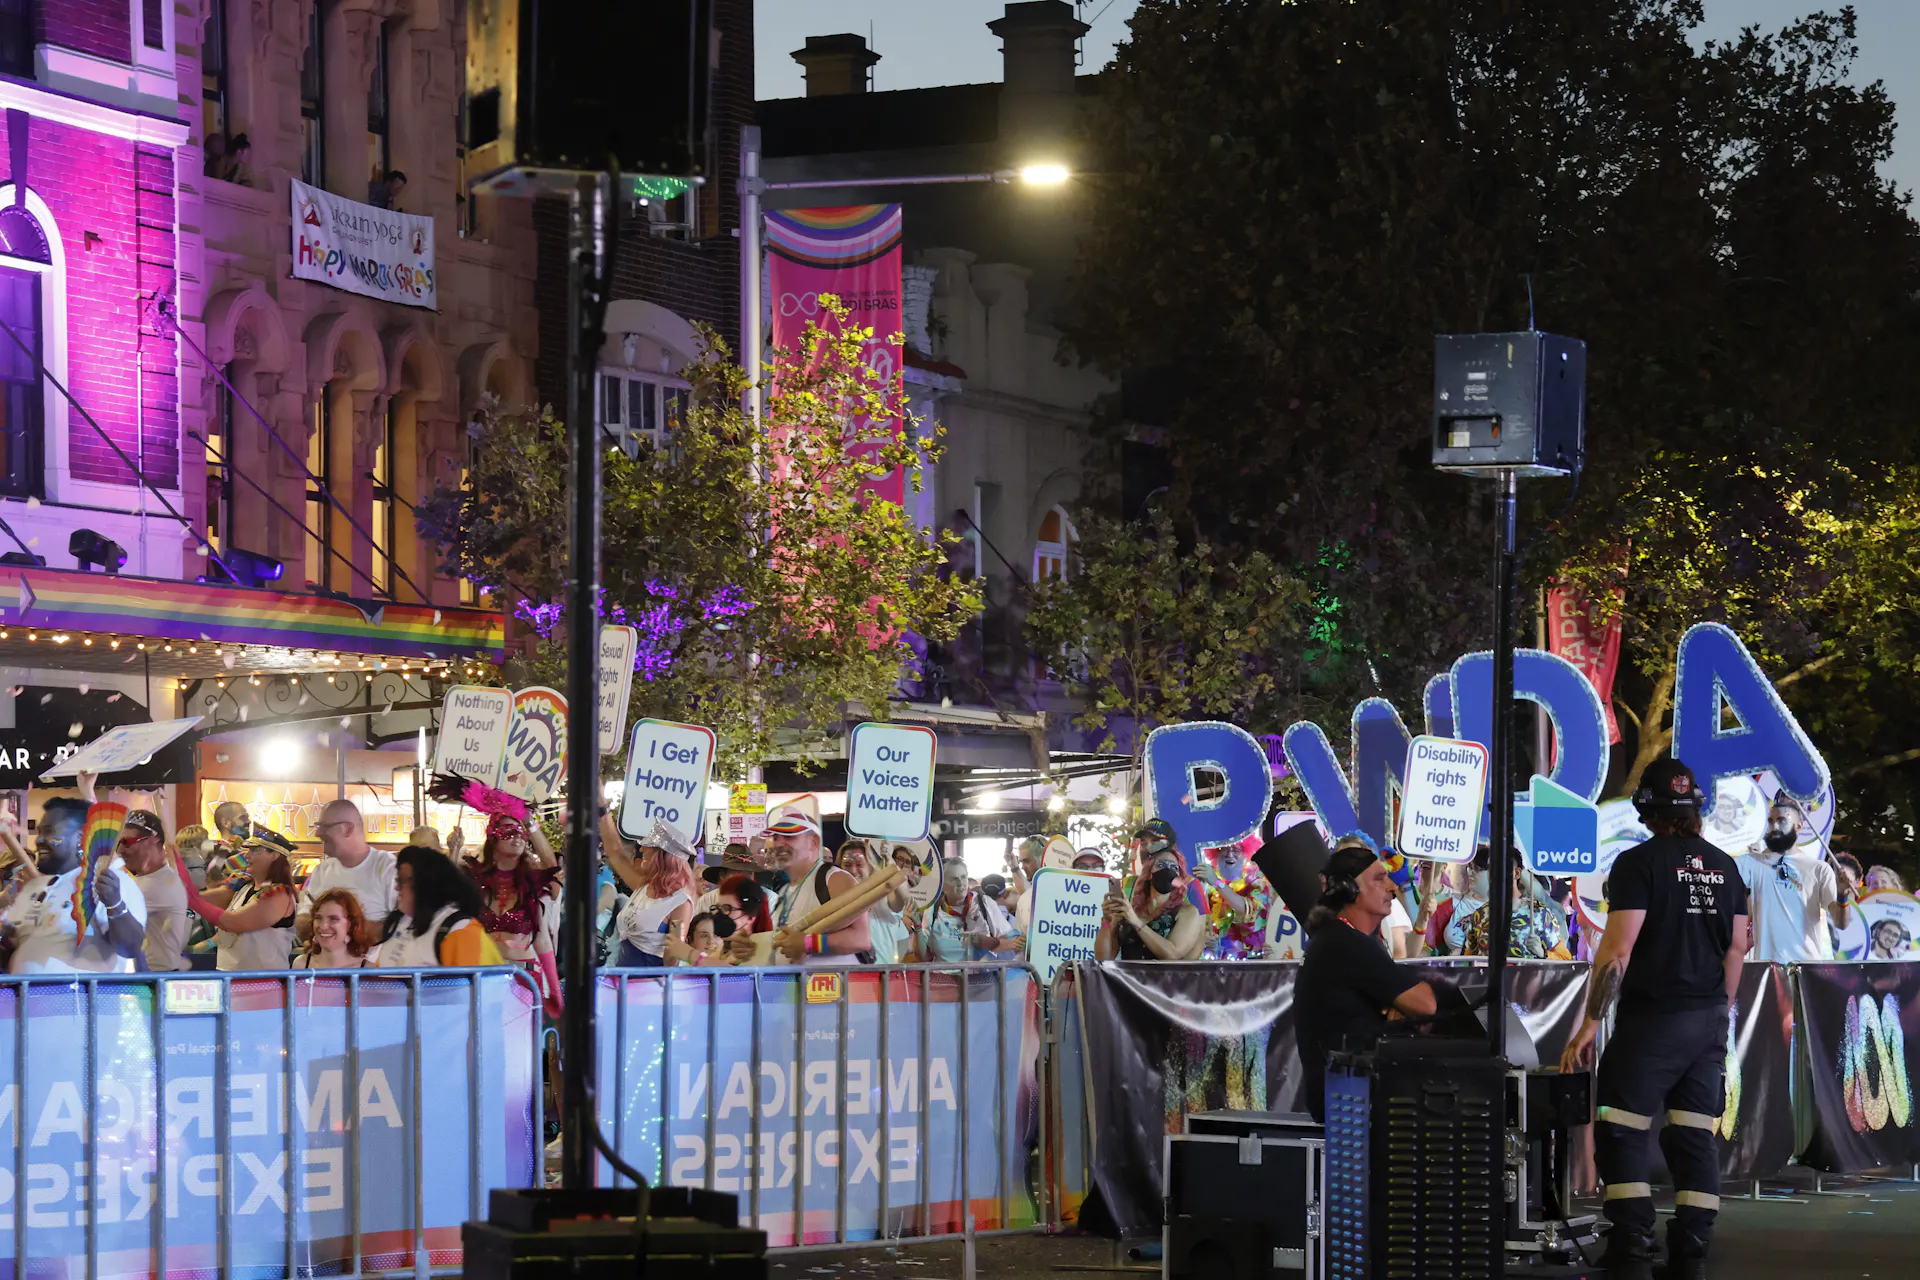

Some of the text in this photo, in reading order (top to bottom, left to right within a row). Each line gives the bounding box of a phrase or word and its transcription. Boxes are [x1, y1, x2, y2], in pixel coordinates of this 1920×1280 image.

[373, 220, 403, 245] yoga
[864, 298, 898, 311] GRAS
[601, 642, 624, 659] Sexual
[454, 694, 504, 715] Nothing
[606, 692, 616, 708] All
[456, 715, 495, 732] About
[523, 696, 567, 755] we are
[464, 737, 480, 752] Us
[649, 739, 699, 765] I Get
[876, 745, 910, 763] Our
[508, 718, 560, 794] WDA
[1417, 744, 1482, 769] Disability
[445, 757, 494, 775] Without
[635, 767, 697, 799] Horny
[862, 768, 919, 789] Voices
[1426, 768, 1467, 787] rights
[858, 792, 919, 813] Matter
[1431, 793, 1456, 808] are
[643, 798, 679, 823] Too
[1415, 810, 1466, 831] human
[1415, 833, 1460, 852] rights!
[1537, 847, 1592, 867] pwda
[1064, 878, 1091, 894] We
[1054, 899, 1098, 917] Want
[1038, 919, 1100, 939] Disabilit
[1047, 942, 1095, 961] Rights
[171, 983, 212, 1001] TFH
[811, 975, 835, 992] TFH
